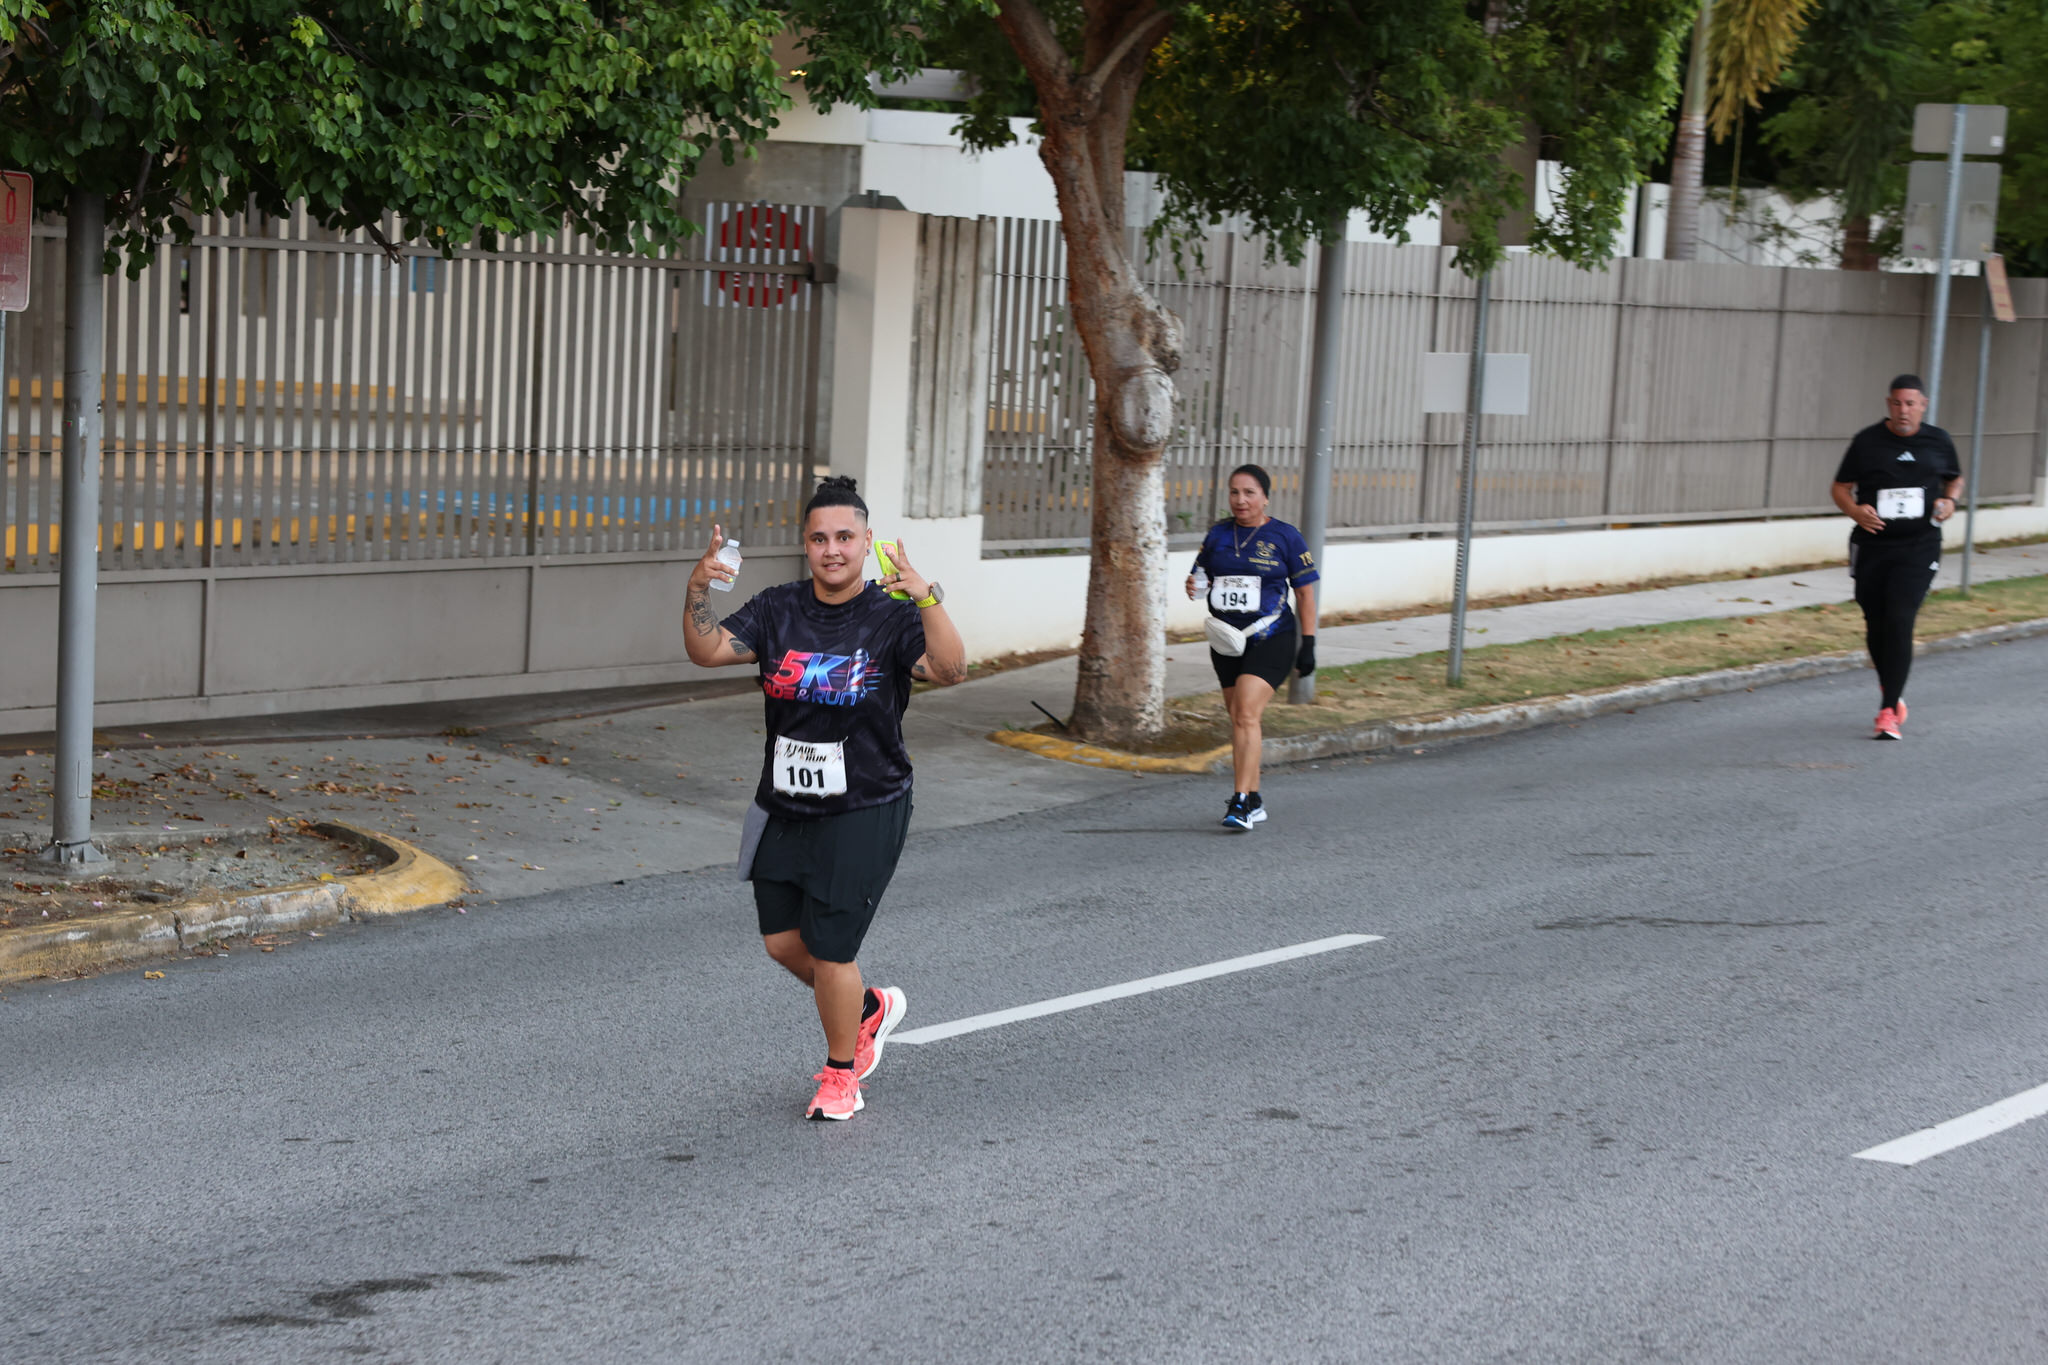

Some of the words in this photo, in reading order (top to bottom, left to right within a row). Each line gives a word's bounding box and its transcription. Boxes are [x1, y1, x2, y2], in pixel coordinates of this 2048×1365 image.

[1221, 592, 1248, 607] 194
[772, 649, 850, 692] 5K
[796, 688, 809, 699] &
[786, 765, 825, 789] 101
